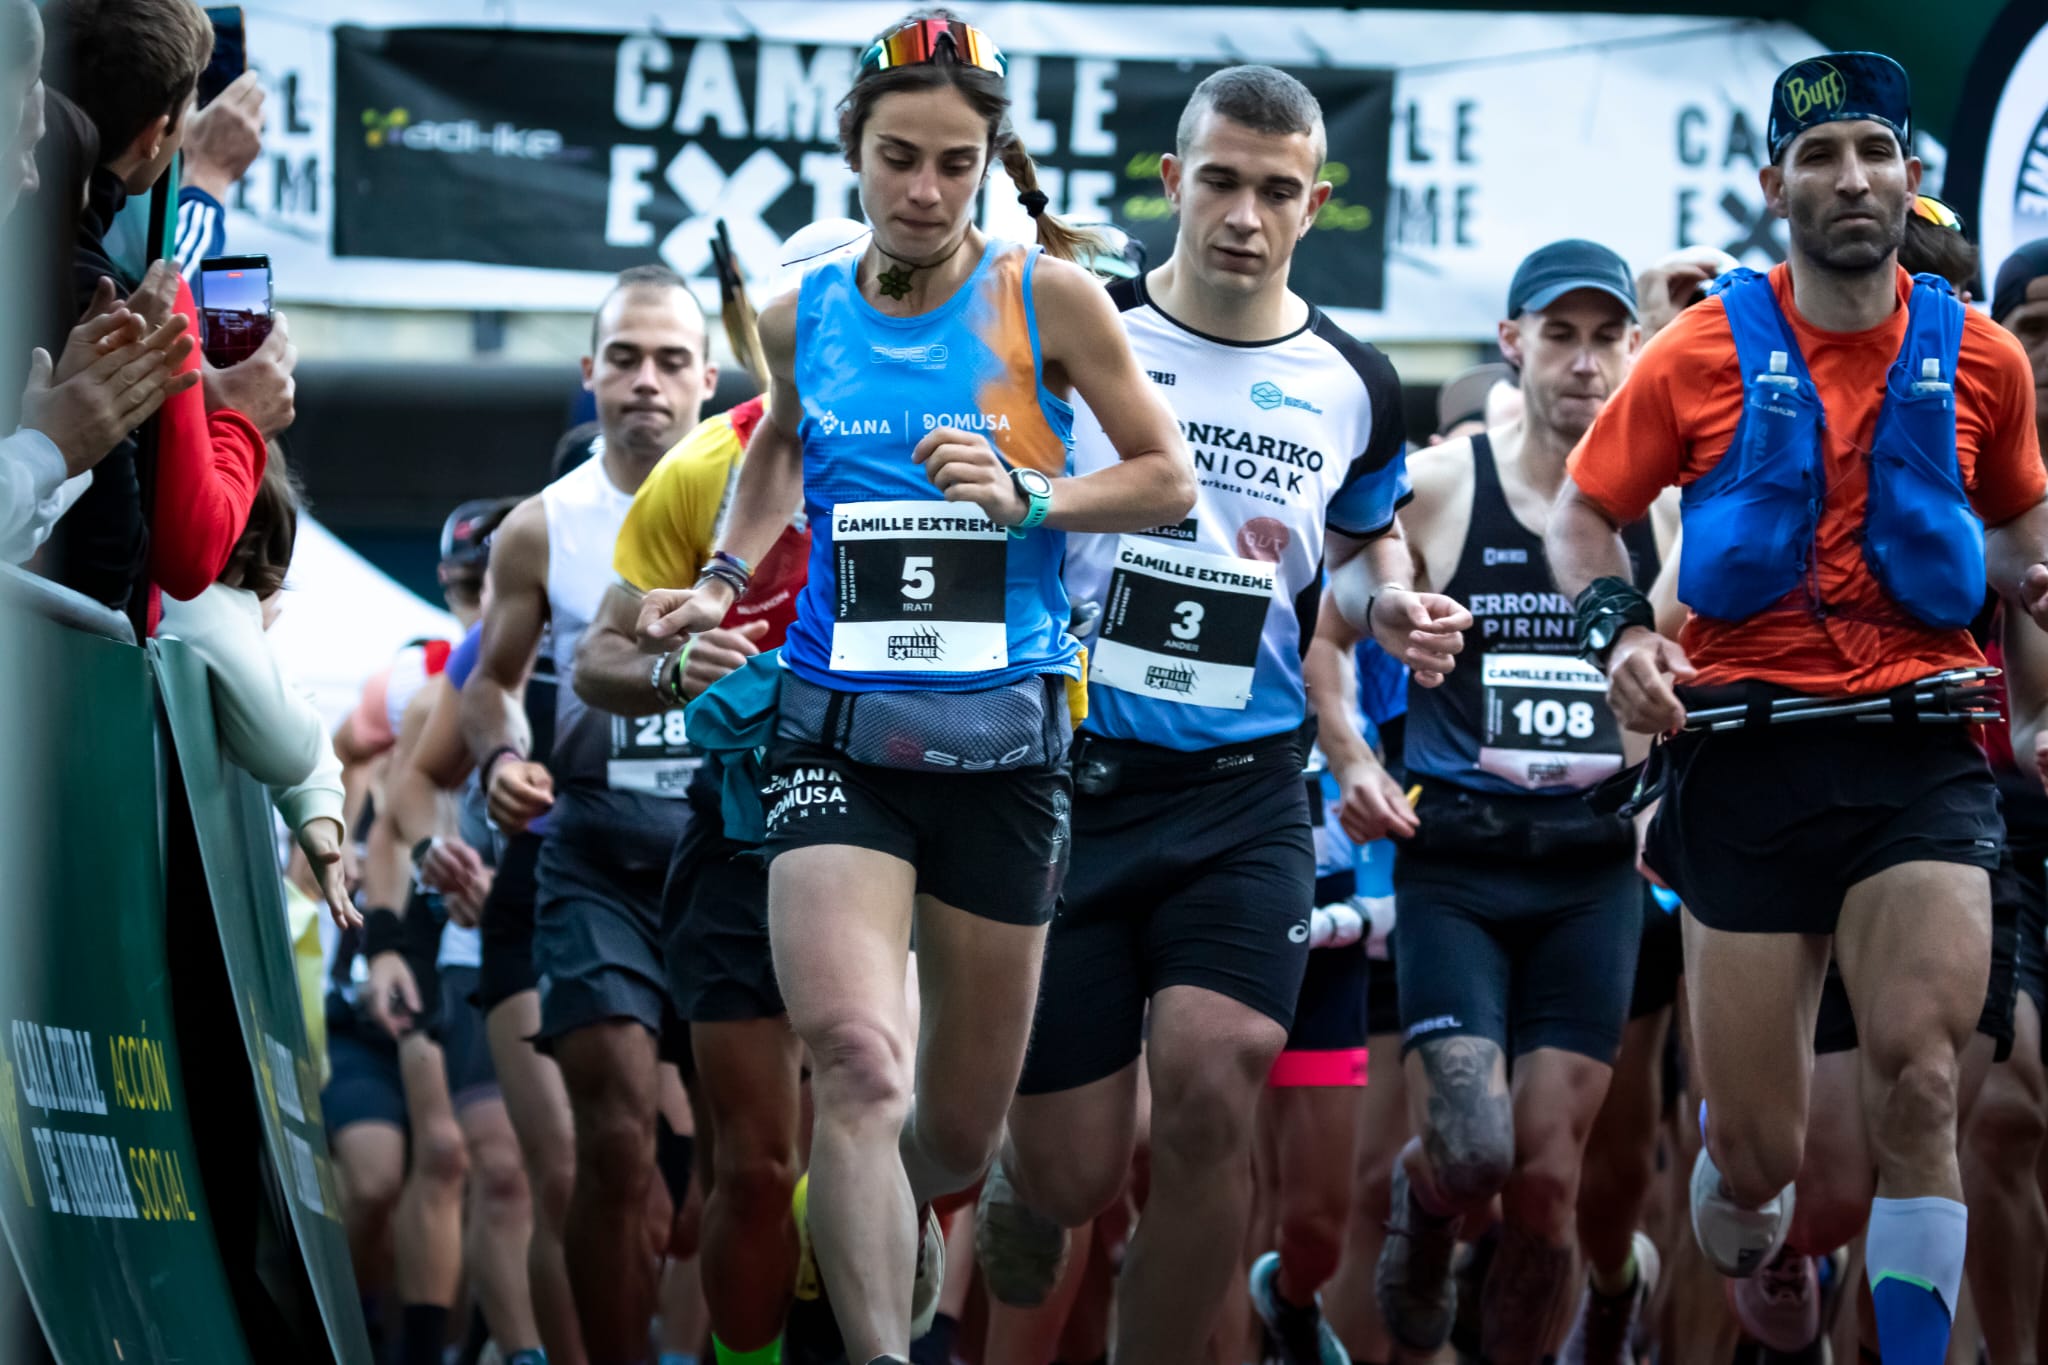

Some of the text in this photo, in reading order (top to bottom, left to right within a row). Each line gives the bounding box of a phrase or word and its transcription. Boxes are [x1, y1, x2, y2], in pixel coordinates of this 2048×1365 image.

[613, 34, 1117, 157] CAMLE
[1786, 71, 1841, 117] Buff
[840, 413, 1011, 436] LANA DOMUSA
[838, 517, 914, 533] CAMILLE
[901, 556, 935, 600] 5
[1121, 550, 1273, 591] CAMILLE EXTREME
[903, 602, 933, 612] IRATI
[1170, 600, 1205, 641] 3
[1483, 618, 1575, 638] PIRINI
[1488, 669, 1551, 681] CAMILLE
[1512, 698, 1595, 739] 108
[109, 1019, 172, 1112] ACCIÓN
[129, 1147, 196, 1221] SOCIAL
